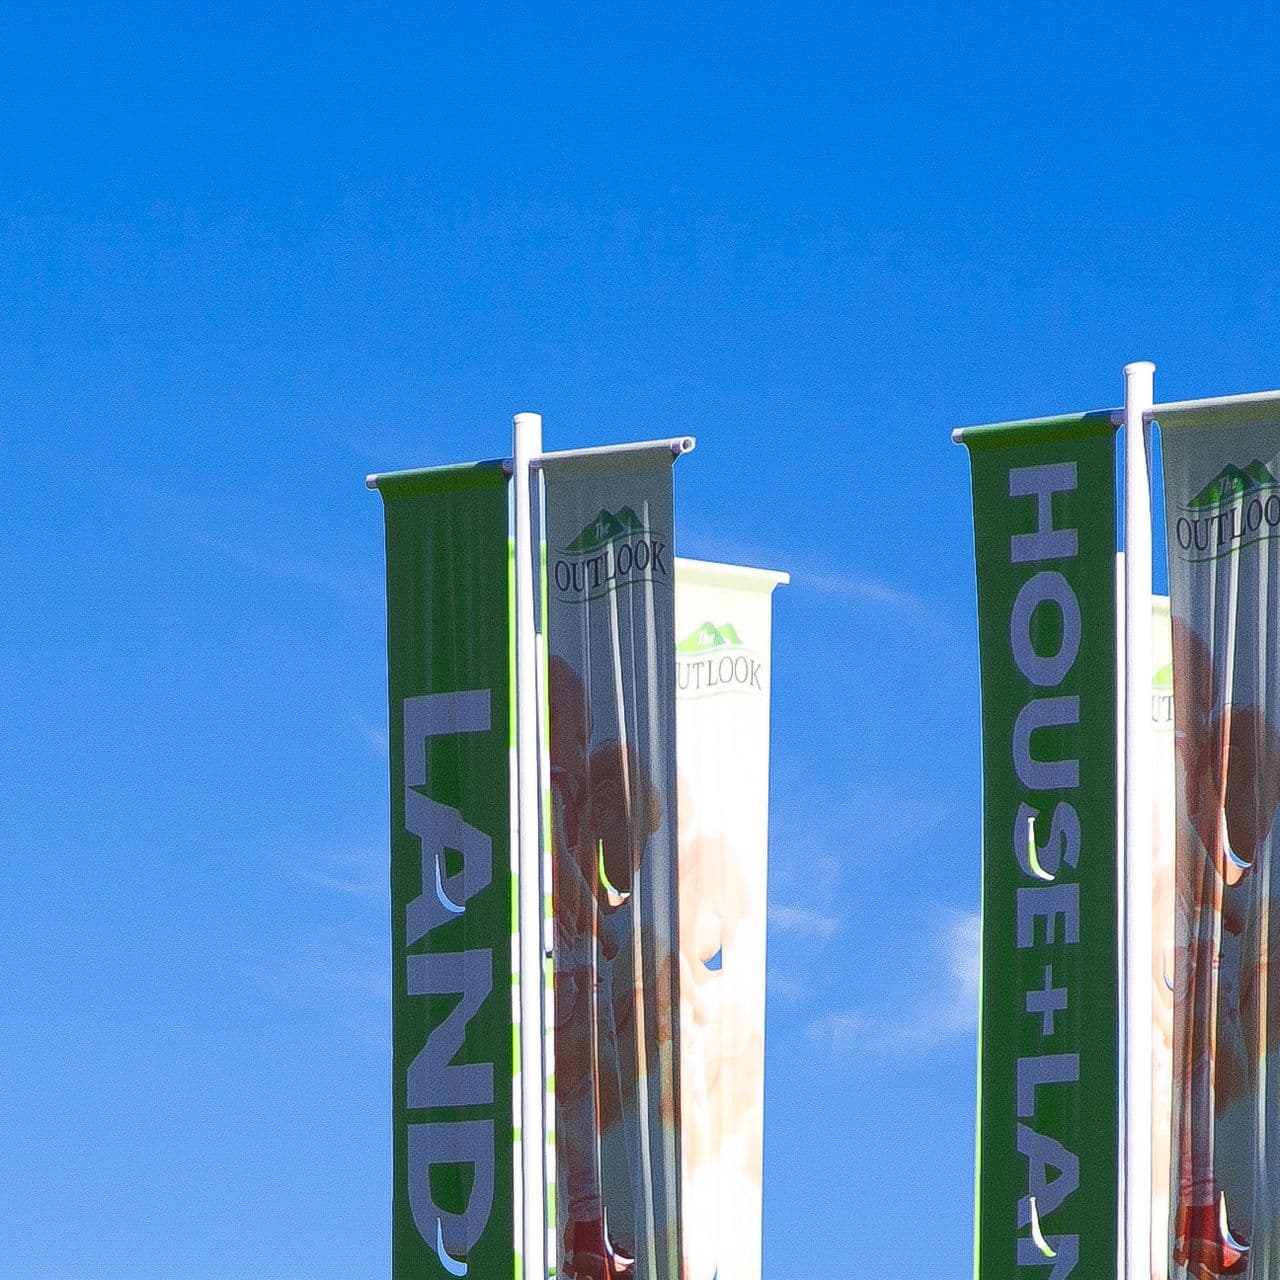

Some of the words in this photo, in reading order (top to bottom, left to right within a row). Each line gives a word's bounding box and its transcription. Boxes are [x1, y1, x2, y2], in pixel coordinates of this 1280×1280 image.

[554, 539, 668, 593] OUTLOOK
[676, 656, 762, 691] UTLOOK
[403, 688, 494, 1260] LAND
